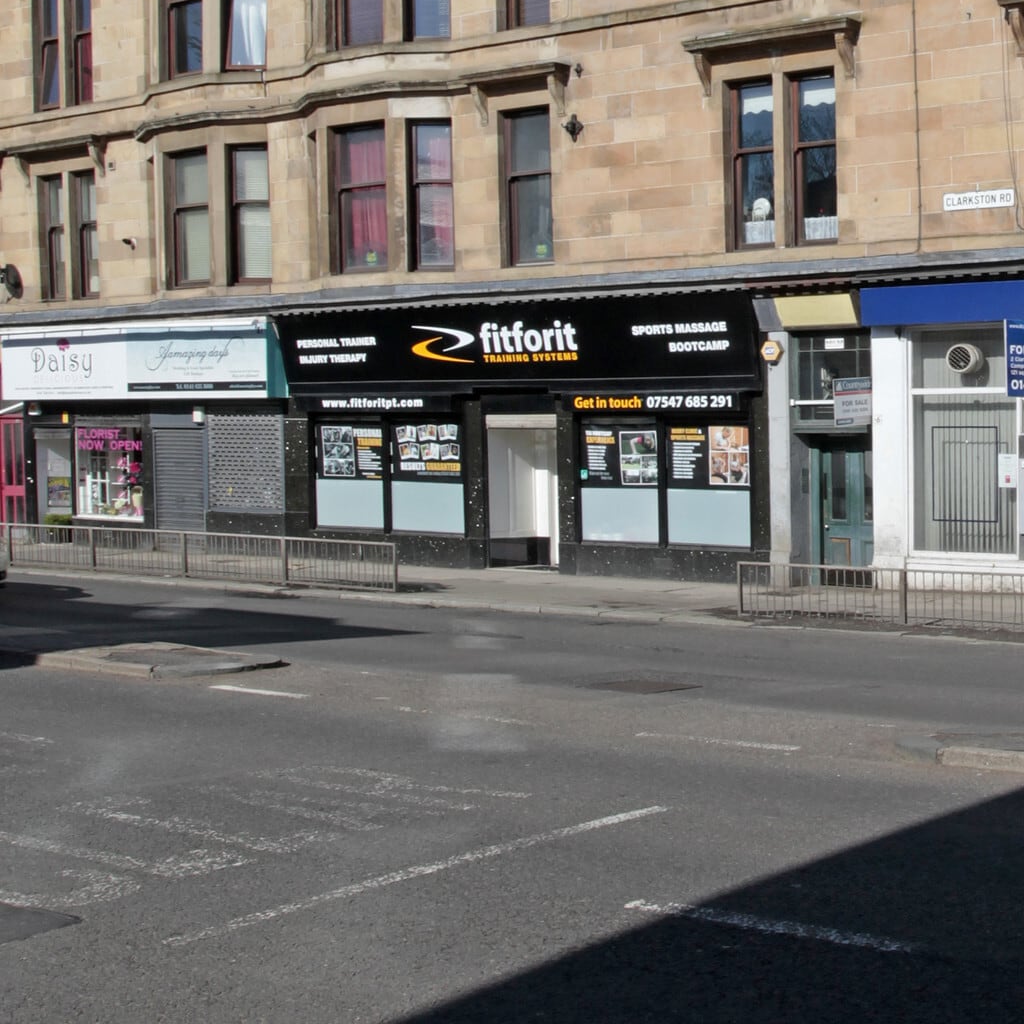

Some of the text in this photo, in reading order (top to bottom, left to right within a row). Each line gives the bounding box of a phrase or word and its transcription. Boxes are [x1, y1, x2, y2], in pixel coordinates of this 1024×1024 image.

[945, 192, 1012, 207] CLARKSTON RD
[631, 321, 727, 336] SPORTS MASSAGE
[296, 336, 377, 349] PERSONAL TRAINER
[479, 320, 578, 353] fitforit
[668, 339, 730, 352] BOOTCAMP
[31, 347, 92, 378] Daisy
[299, 353, 367, 364] INJURY THERAPY
[483, 352, 578, 363] TRAINING SYSTEMS
[322, 397, 423, 410] www.fitforitpt.com
[574, 394, 733, 409] Get in touch 07547 685 291
[77, 428, 120, 439] FLORIST
[78, 439, 143, 451] NOW OPEN!
